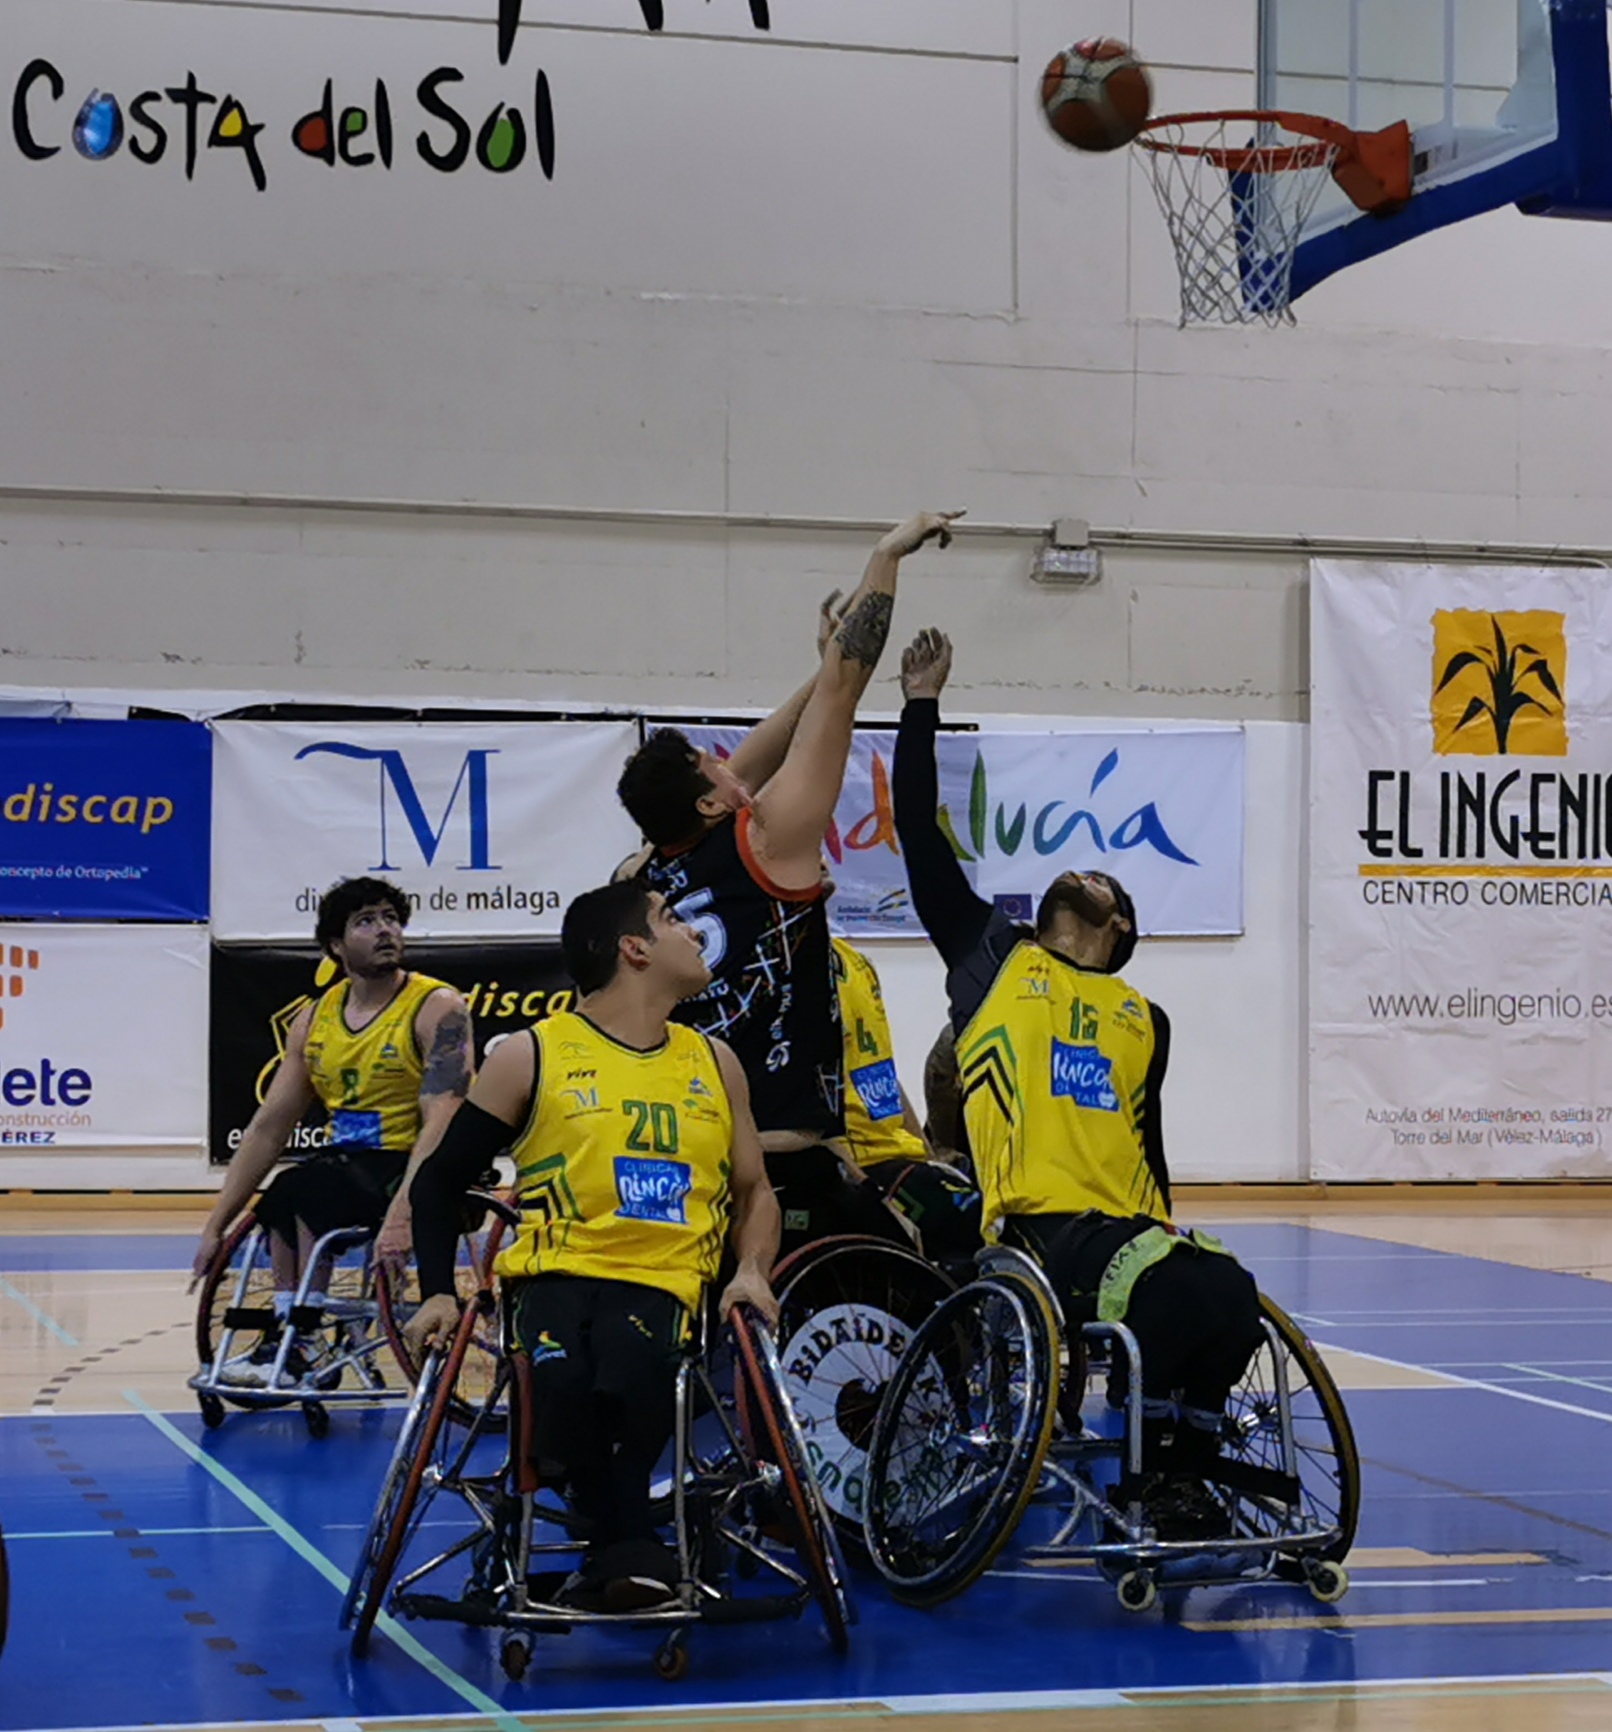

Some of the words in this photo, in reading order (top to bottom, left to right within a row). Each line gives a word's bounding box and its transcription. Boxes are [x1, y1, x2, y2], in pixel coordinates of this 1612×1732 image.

[13, 59, 265, 192] Costa
[293, 77, 392, 170] del
[416, 66, 555, 181] Sol
[3, 782, 174, 834] discap
[1358, 770, 1424, 858] EL
[1440, 769, 1612, 860] INGENI
[56, 864, 72, 878] de
[430, 886, 458, 912] de
[467, 885, 560, 916] málaga
[1363, 879, 1470, 906] CENTRO
[856, 1018, 878, 1056] 4
[2, 1058, 92, 1107] ete
[621, 1099, 679, 1155] 20
[1421, 1107, 1445, 1124] del
[1391, 1128, 1426, 1145] Torre
[1429, 1128, 1453, 1145] del
[1457, 1128, 1484, 1145] Mar
